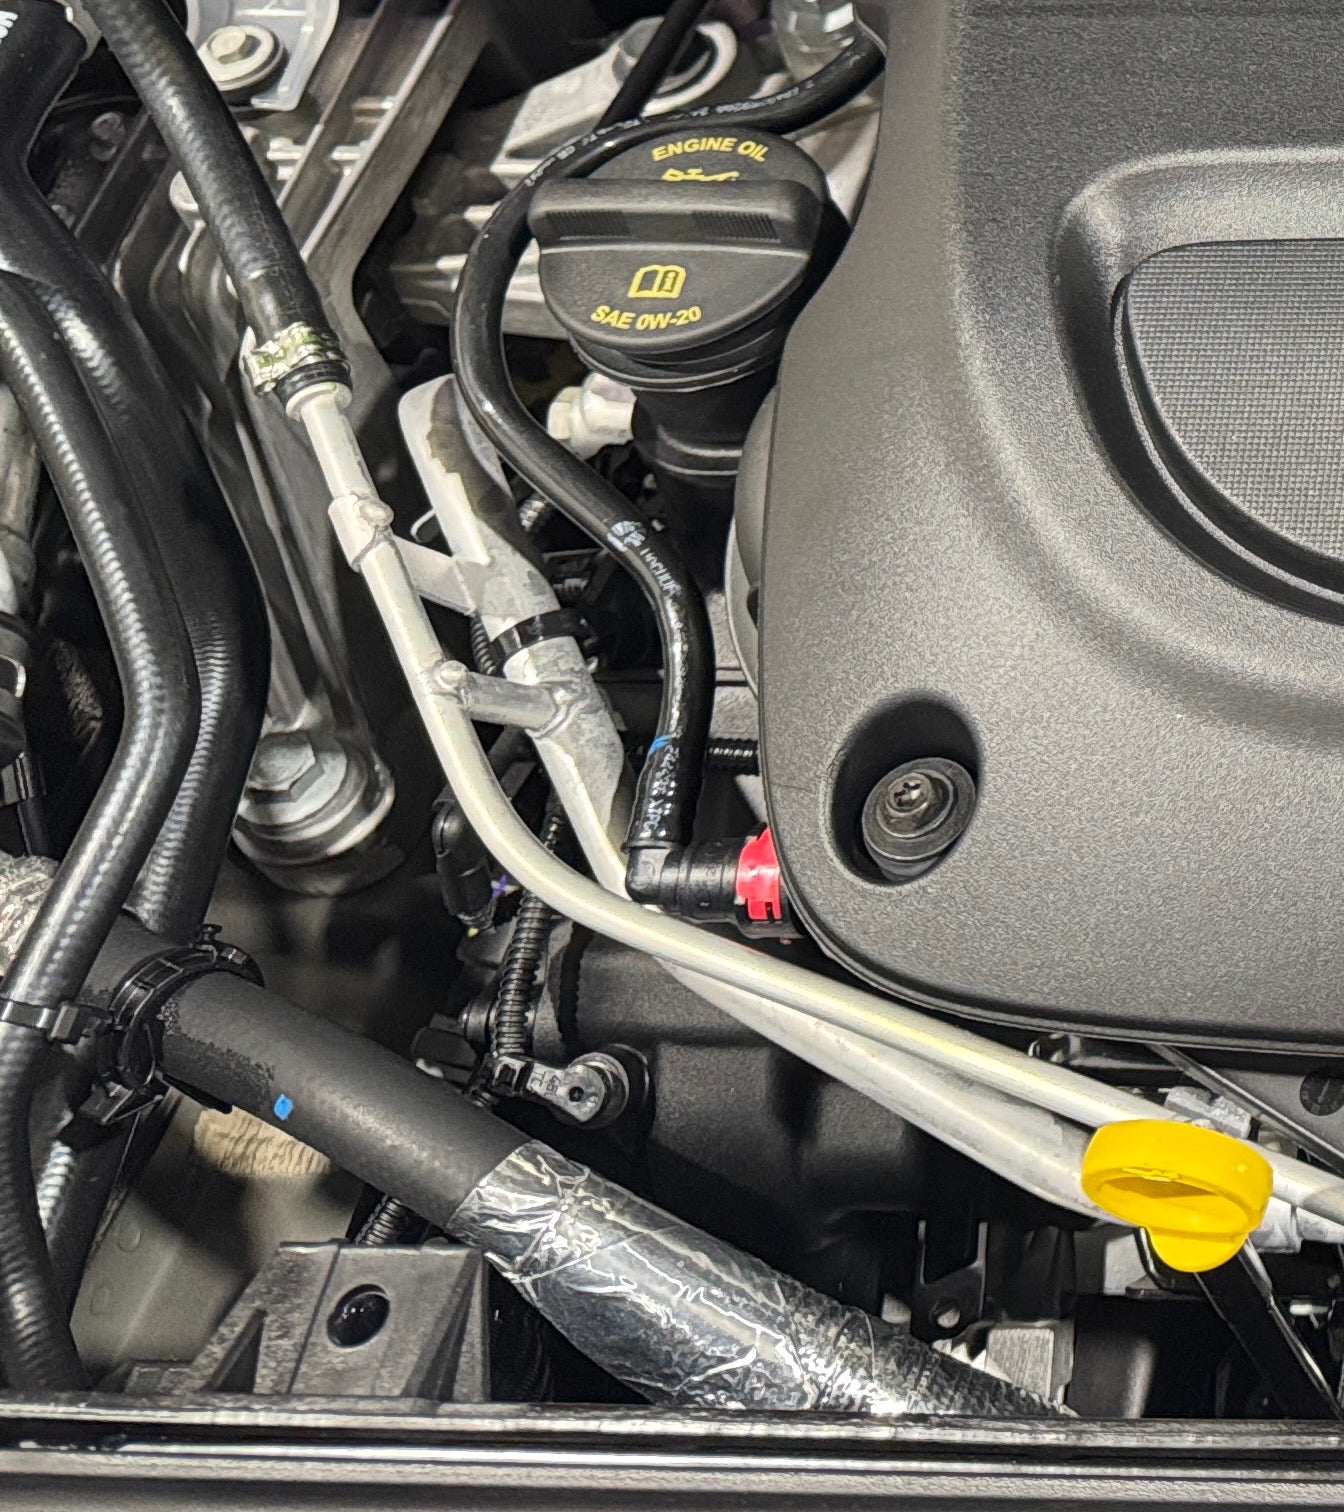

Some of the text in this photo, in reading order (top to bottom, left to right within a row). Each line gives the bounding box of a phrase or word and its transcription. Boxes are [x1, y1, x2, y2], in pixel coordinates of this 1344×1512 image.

[652, 136, 769, 162] ENGINE OIL
[590, 305, 702, 331] SAE 0W-20
